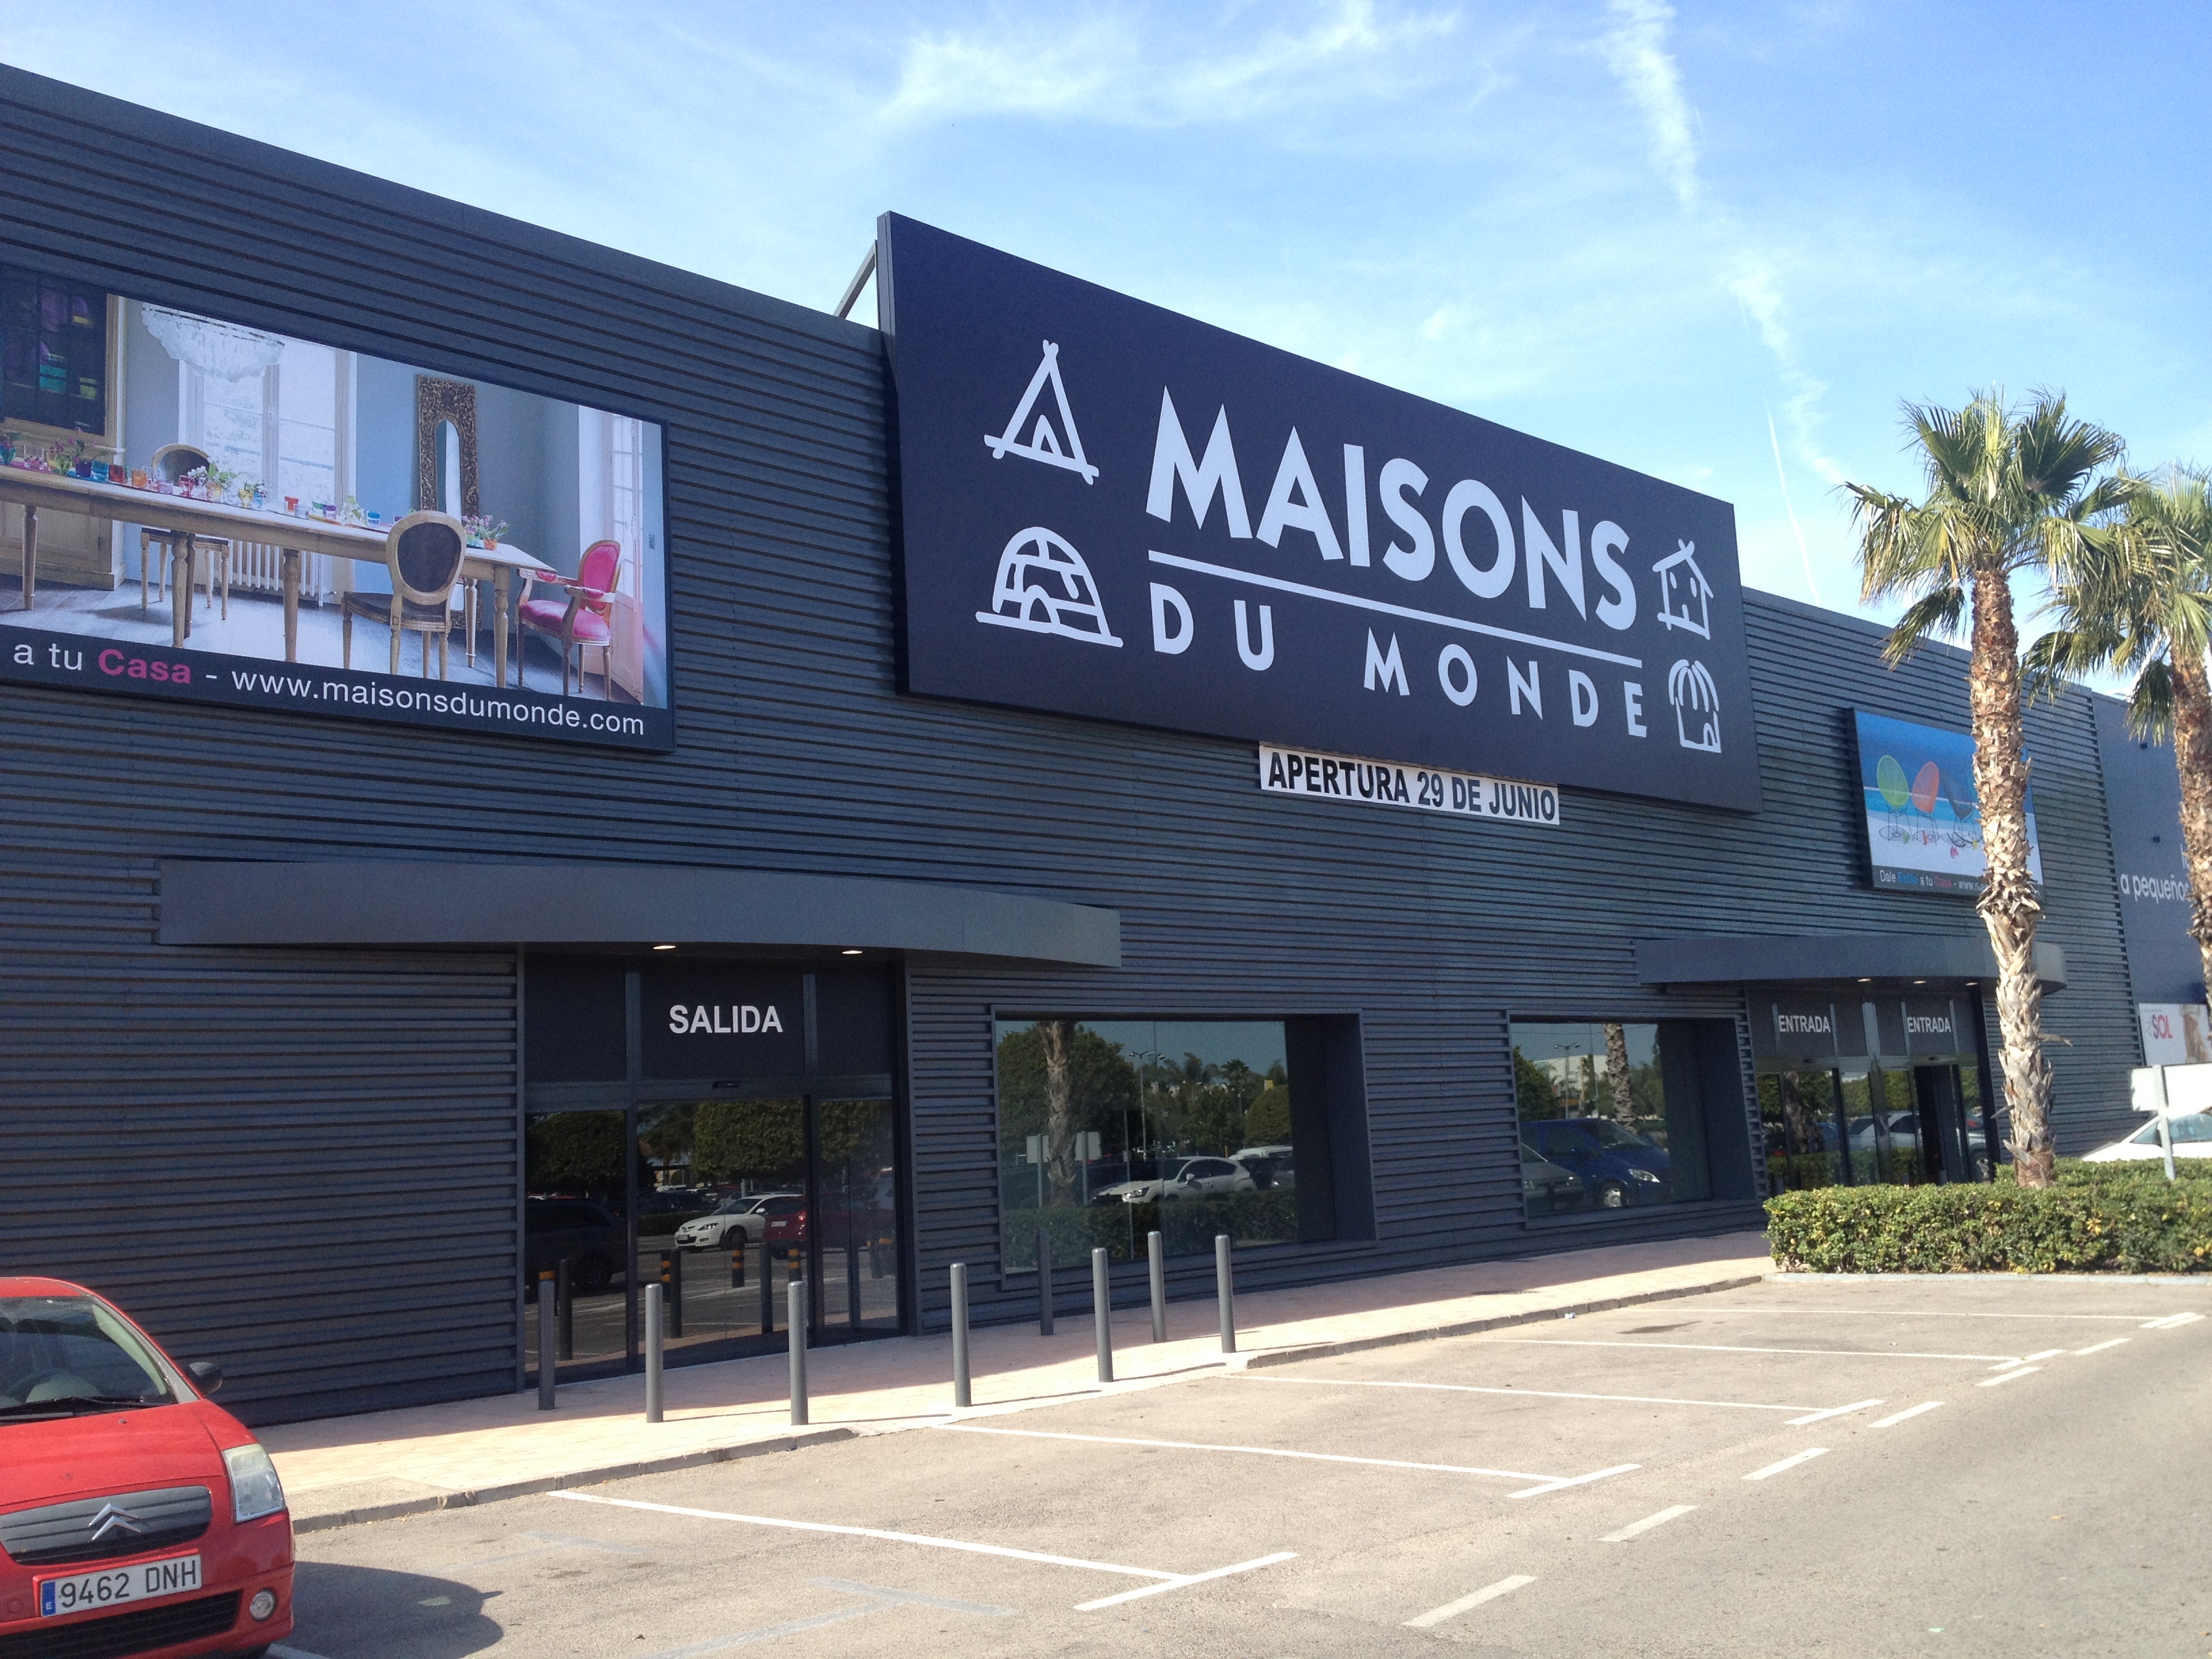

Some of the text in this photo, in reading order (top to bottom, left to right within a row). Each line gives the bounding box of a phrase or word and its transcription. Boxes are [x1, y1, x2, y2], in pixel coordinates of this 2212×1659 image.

[1146, 385, 1637, 630] MAISONS
[1149, 582, 1647, 738] DU MONDE
[13, 644, 34, 665] a
[49, 644, 83, 670] tu
[98, 648, 191, 684] Casa
[232, 668, 644, 735] www.maisonsdumonde.com
[1268, 752, 1556, 821] APERTURA 29 DE JUNIO
[1879, 870, 1896, 882] Dale
[1920, 876, 1925, 885] a
[1925, 876, 1933, 886] tu
[2120, 873, 2130, 895] a
[669, 1004, 783, 1033] SALIDA
[1778, 1015, 1830, 1033] ENTRADA
[1907, 1017, 1952, 1033] ENTRADA
[2152, 1014, 2173, 1039] SOL
[47, 1560, 197, 1611] E 9462 DNH
